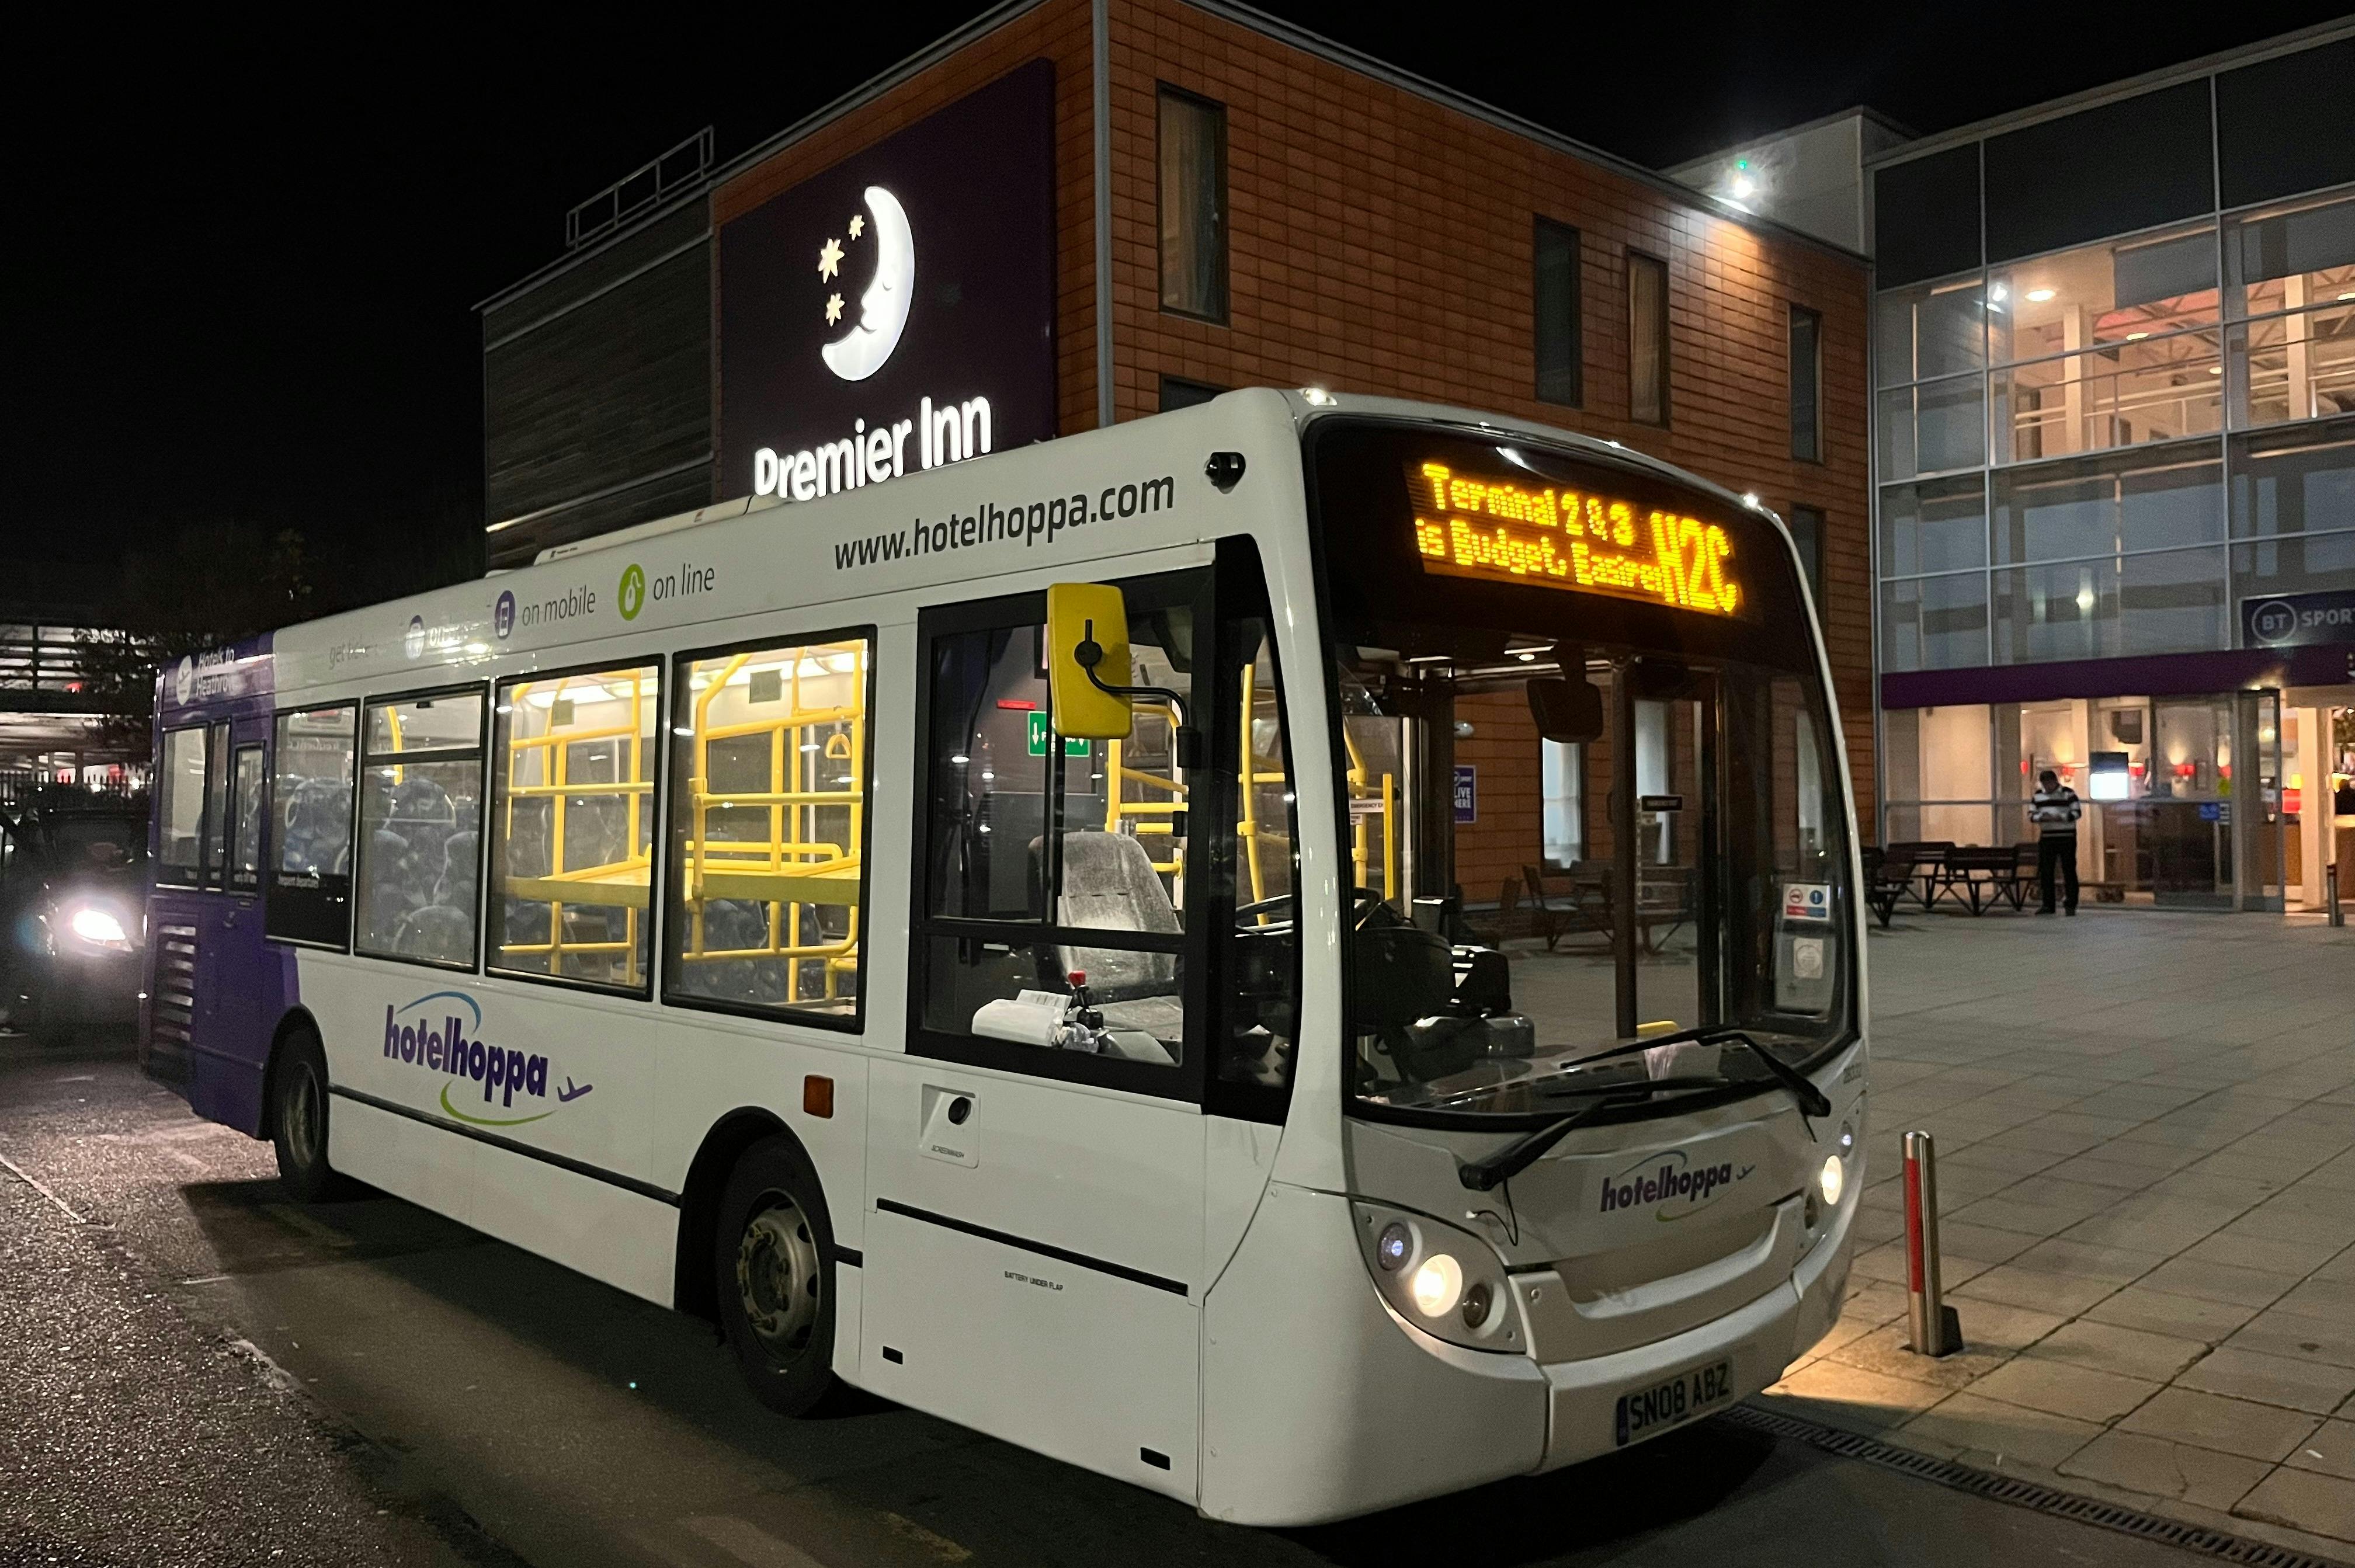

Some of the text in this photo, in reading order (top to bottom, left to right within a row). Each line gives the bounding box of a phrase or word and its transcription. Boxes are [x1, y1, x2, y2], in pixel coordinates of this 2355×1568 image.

[754, 396, 991, 501] Premier Inn
[835, 475, 1175, 570] www.hotelhoppa.com
[1422, 463, 1558, 526] Terminal
[1561, 493, 1584, 536] 2
[1450, 520, 1567, 575] Budget,
[522, 585, 596, 626] on mobile
[653, 563, 715, 601] on line
[2262, 608, 2355, 631] BT SPOR
[384, 1004, 548, 1108] hotelhoppa
[1600, 1162, 1732, 1212] hotelhoppa
[1004, 1270, 1064, 1291] BATTERY UNDER FLAP
[1630, 1361, 1730, 1430] SN08 ABZ
